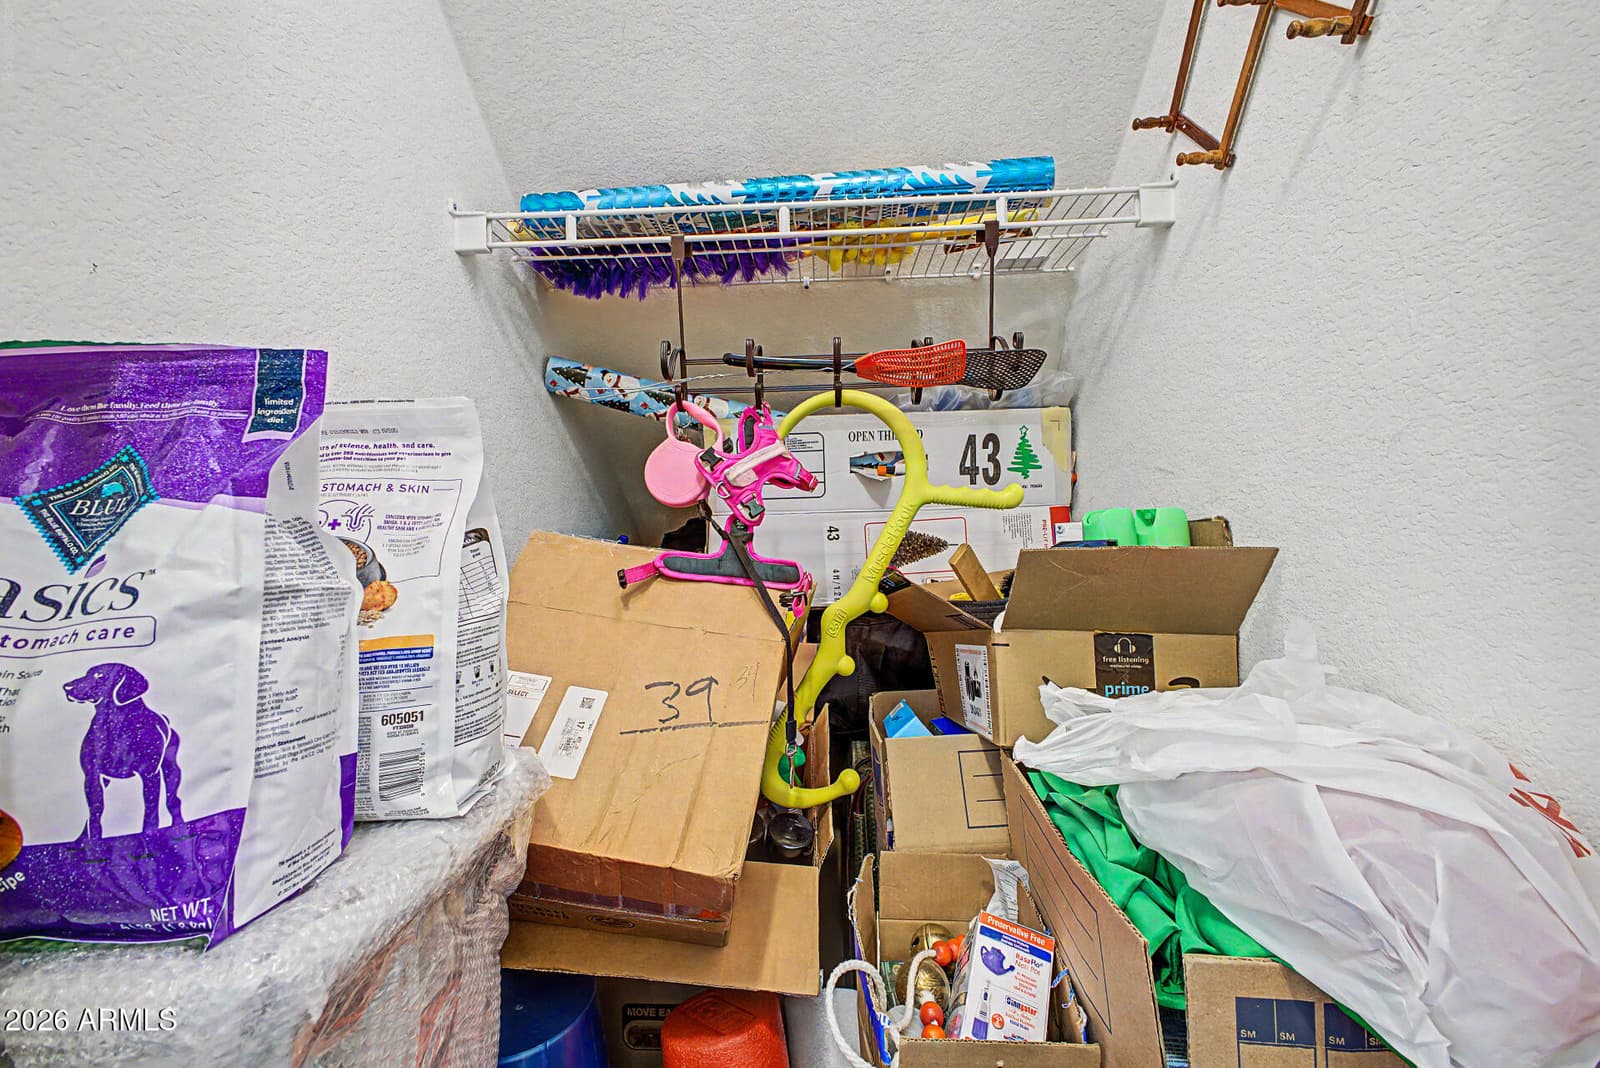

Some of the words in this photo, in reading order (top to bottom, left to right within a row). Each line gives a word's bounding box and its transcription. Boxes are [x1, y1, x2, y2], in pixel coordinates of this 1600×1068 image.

[264, 397, 294, 406] limited
[848, 430, 875, 442] OPEN
[877, 429, 896, 441] THI
[339, 442, 371, 450] science,
[401, 441, 416, 449] and
[959, 433, 1002, 486] 43
[321, 483, 382, 493] STOMACH
[386, 483, 394, 493] &
[399, 483, 430, 494] SKIN
[69, 495, 133, 516] BLUE
[827, 525, 840, 541] 43
[86, 626, 135, 641] care
[1102, 655, 1117, 663] free
[1118, 655, 1150, 665] listening
[1104, 681, 1150, 698] prime
[645, 675, 719, 724] 39
[381, 710, 424, 727] 605051
[150, 905, 179, 922] NET
[183, 896, 213, 919] WT.
[987, 915, 1030, 940] Preservative
[1029, 932, 1046, 947] Free
[627, 1007, 657, 1017] MOVE
[1240, 1029, 1257, 1039] SM
[1279, 1032, 1296, 1041] SM
[1328, 1035, 1345, 1046] SM
